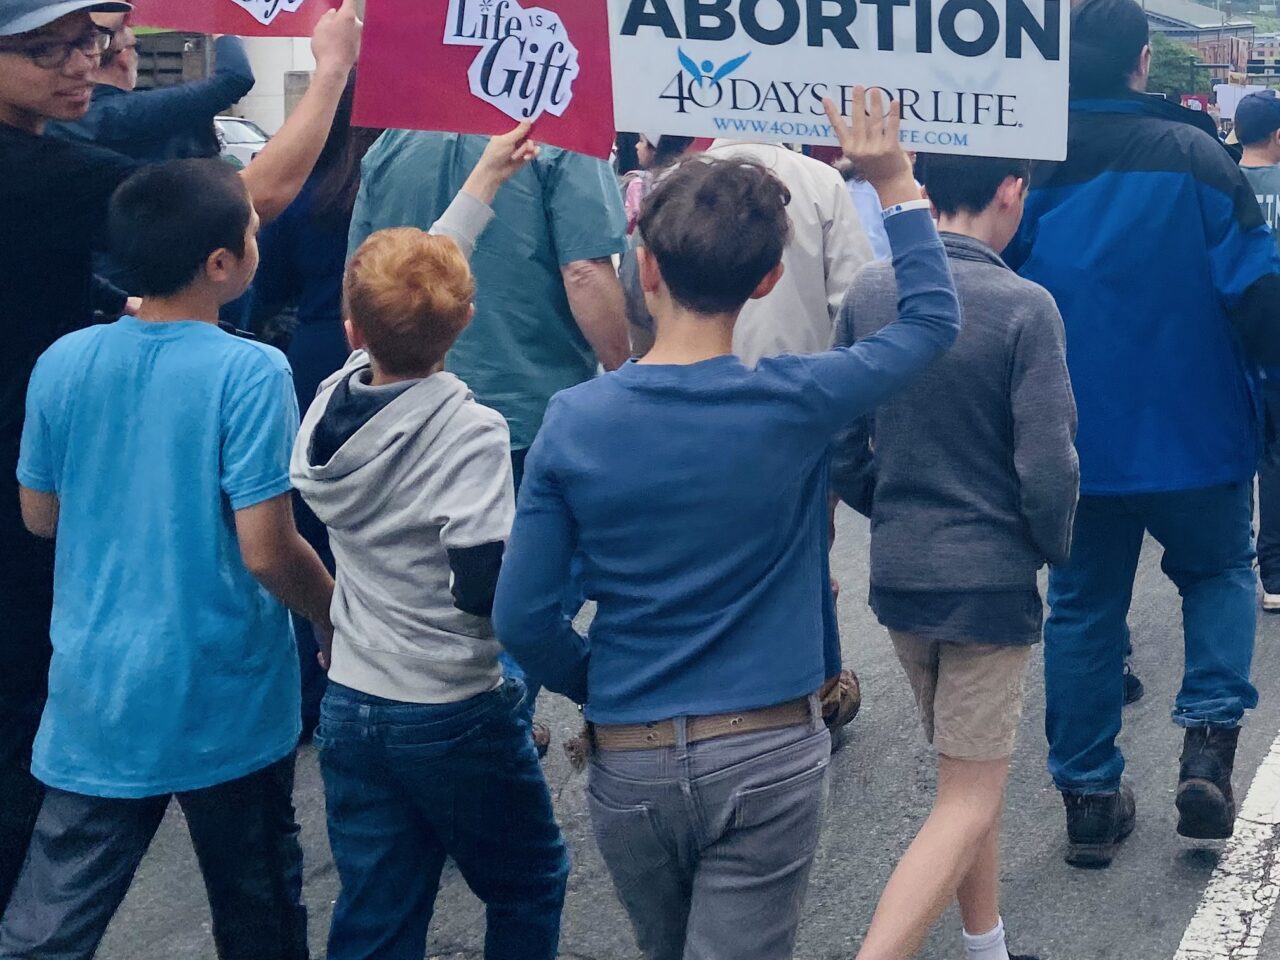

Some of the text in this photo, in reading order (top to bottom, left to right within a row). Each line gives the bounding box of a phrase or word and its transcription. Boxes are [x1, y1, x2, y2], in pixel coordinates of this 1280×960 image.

[529, 15, 543, 27] IS
[547, 22, 557, 35] A
[480, 34, 572, 118] Gift
[658, 70, 723, 113] 40
[728, 78, 828, 116] DAYS
[838, 84, 927, 122] FOR
